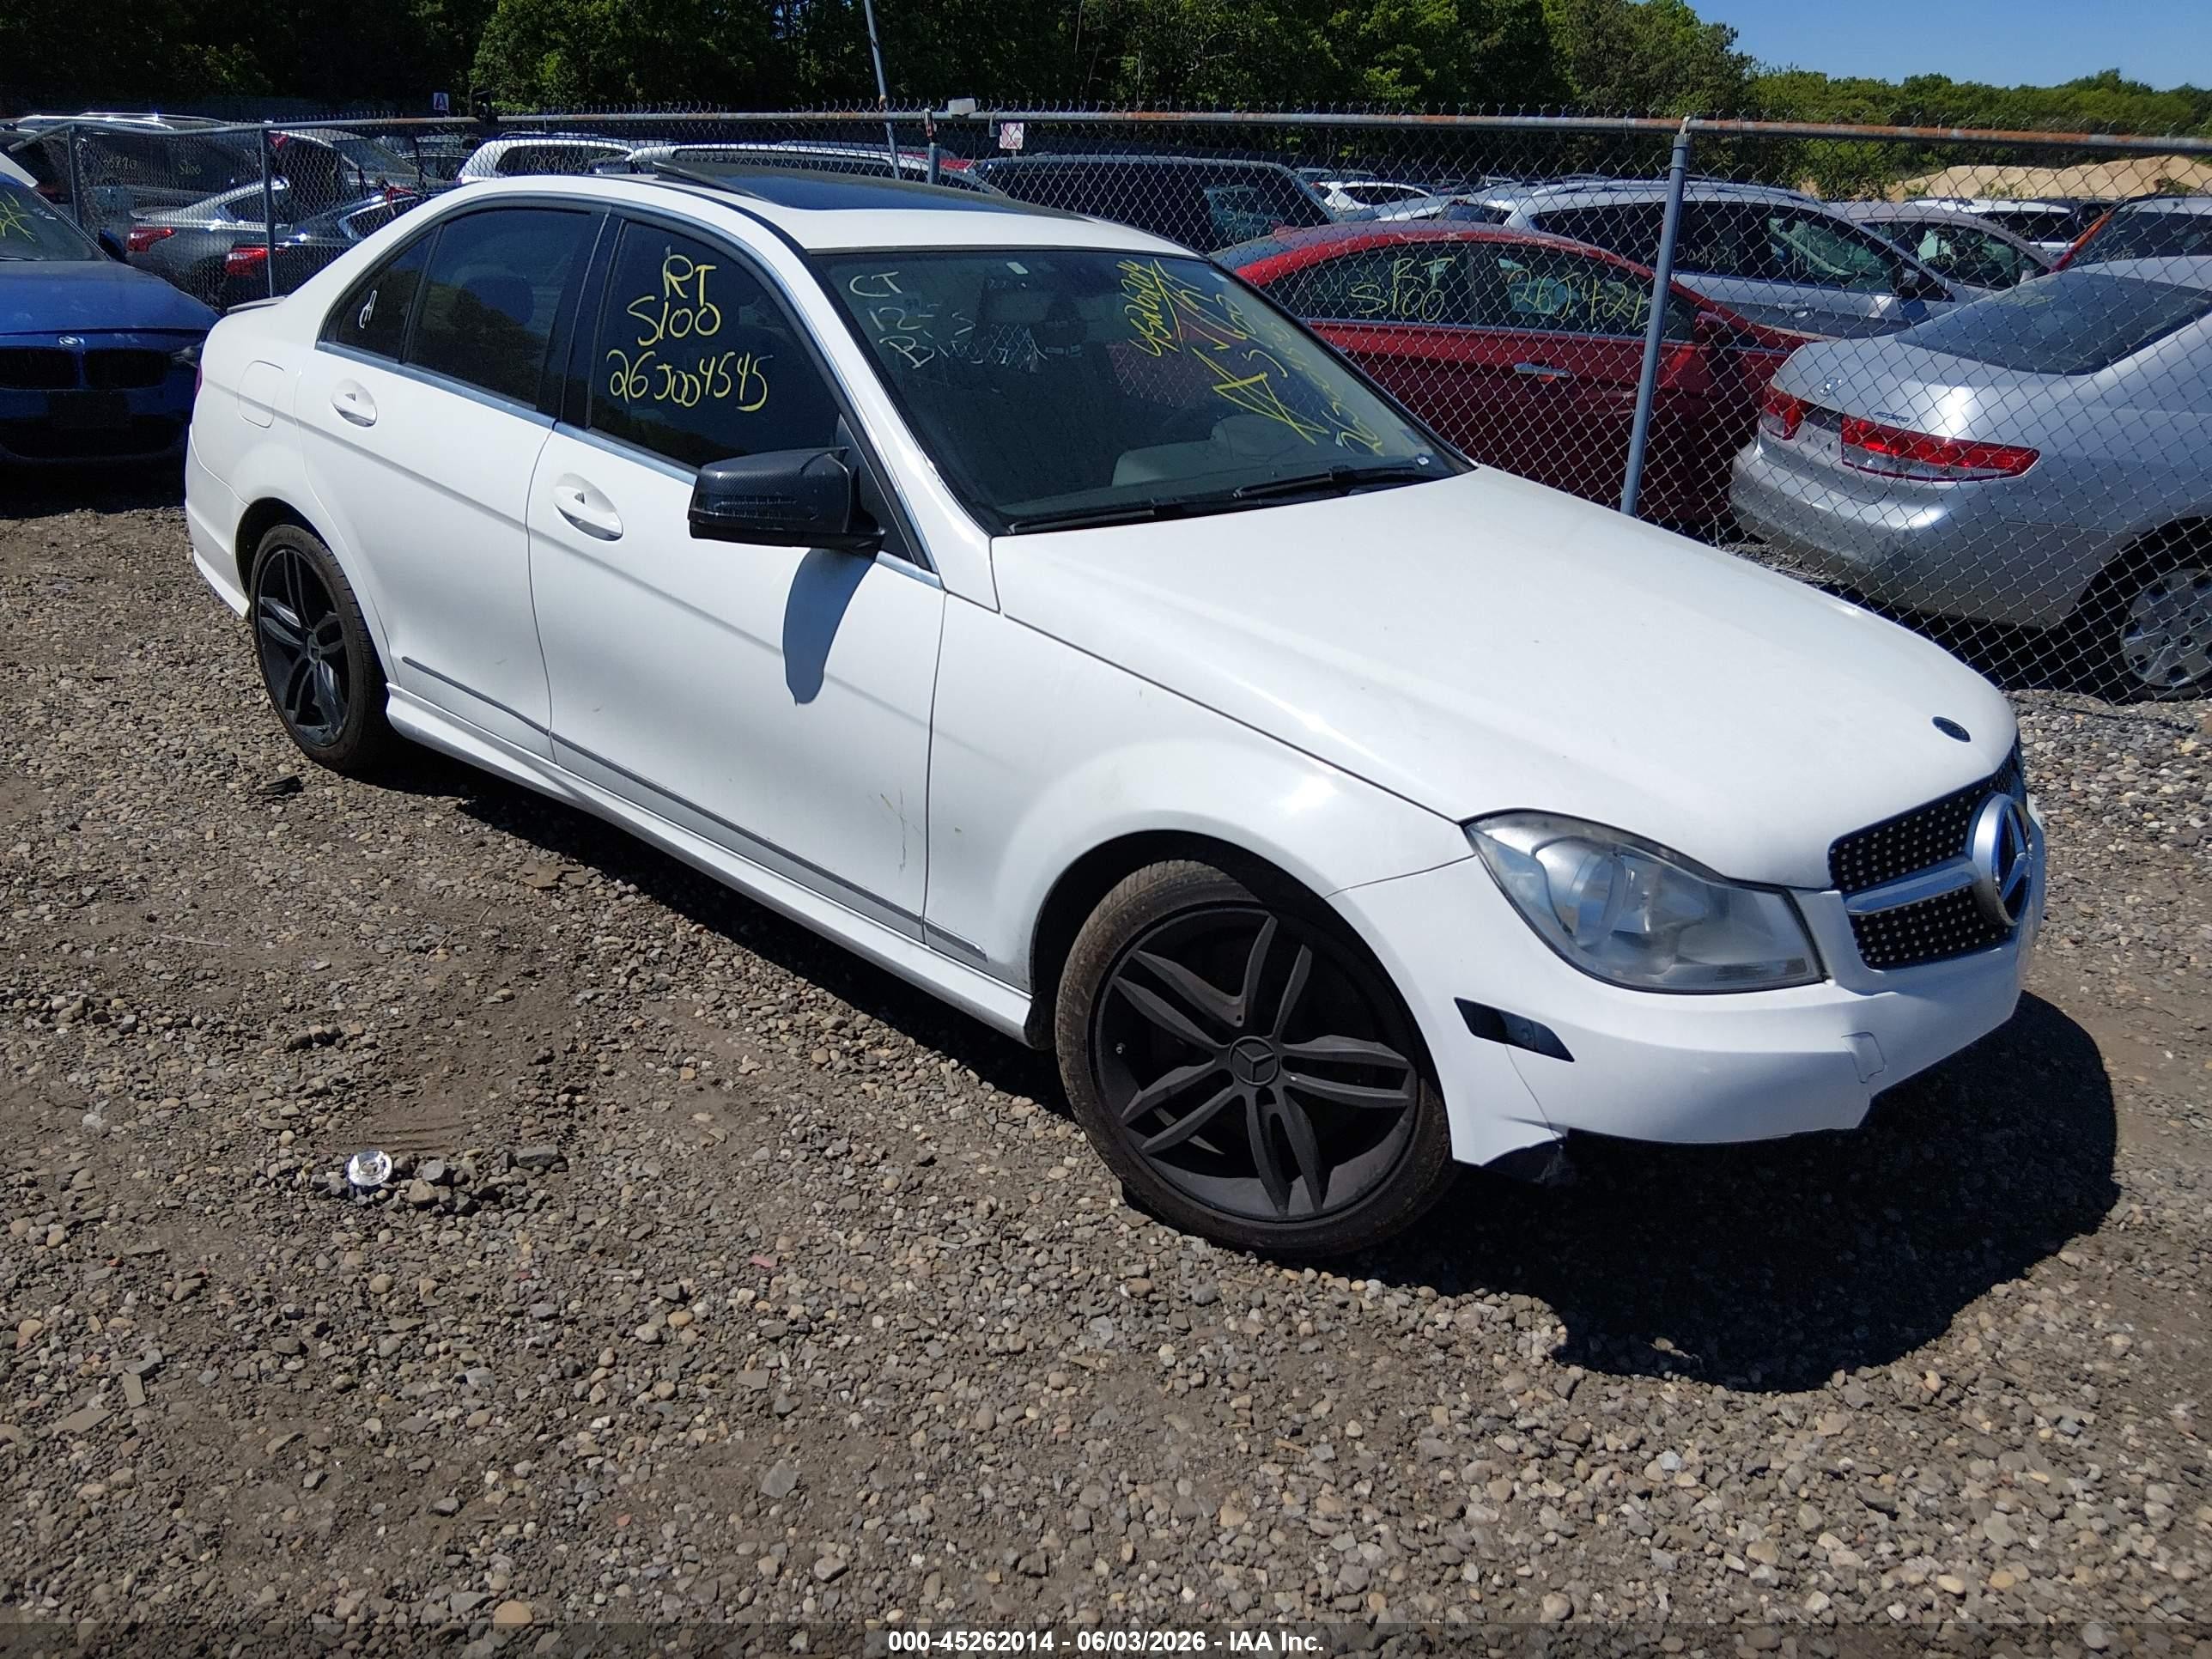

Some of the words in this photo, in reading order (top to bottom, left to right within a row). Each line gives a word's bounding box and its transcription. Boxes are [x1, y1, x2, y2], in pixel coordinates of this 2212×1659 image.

[434, 94, 447, 109] A
[661, 252, 717, 307] RT
[849, 270, 902, 297] CT
[1393, 257, 1456, 289] RT
[627, 295, 721, 346] S100
[1349, 282, 1445, 322] S100
[606, 349, 774, 411] 26J004545
